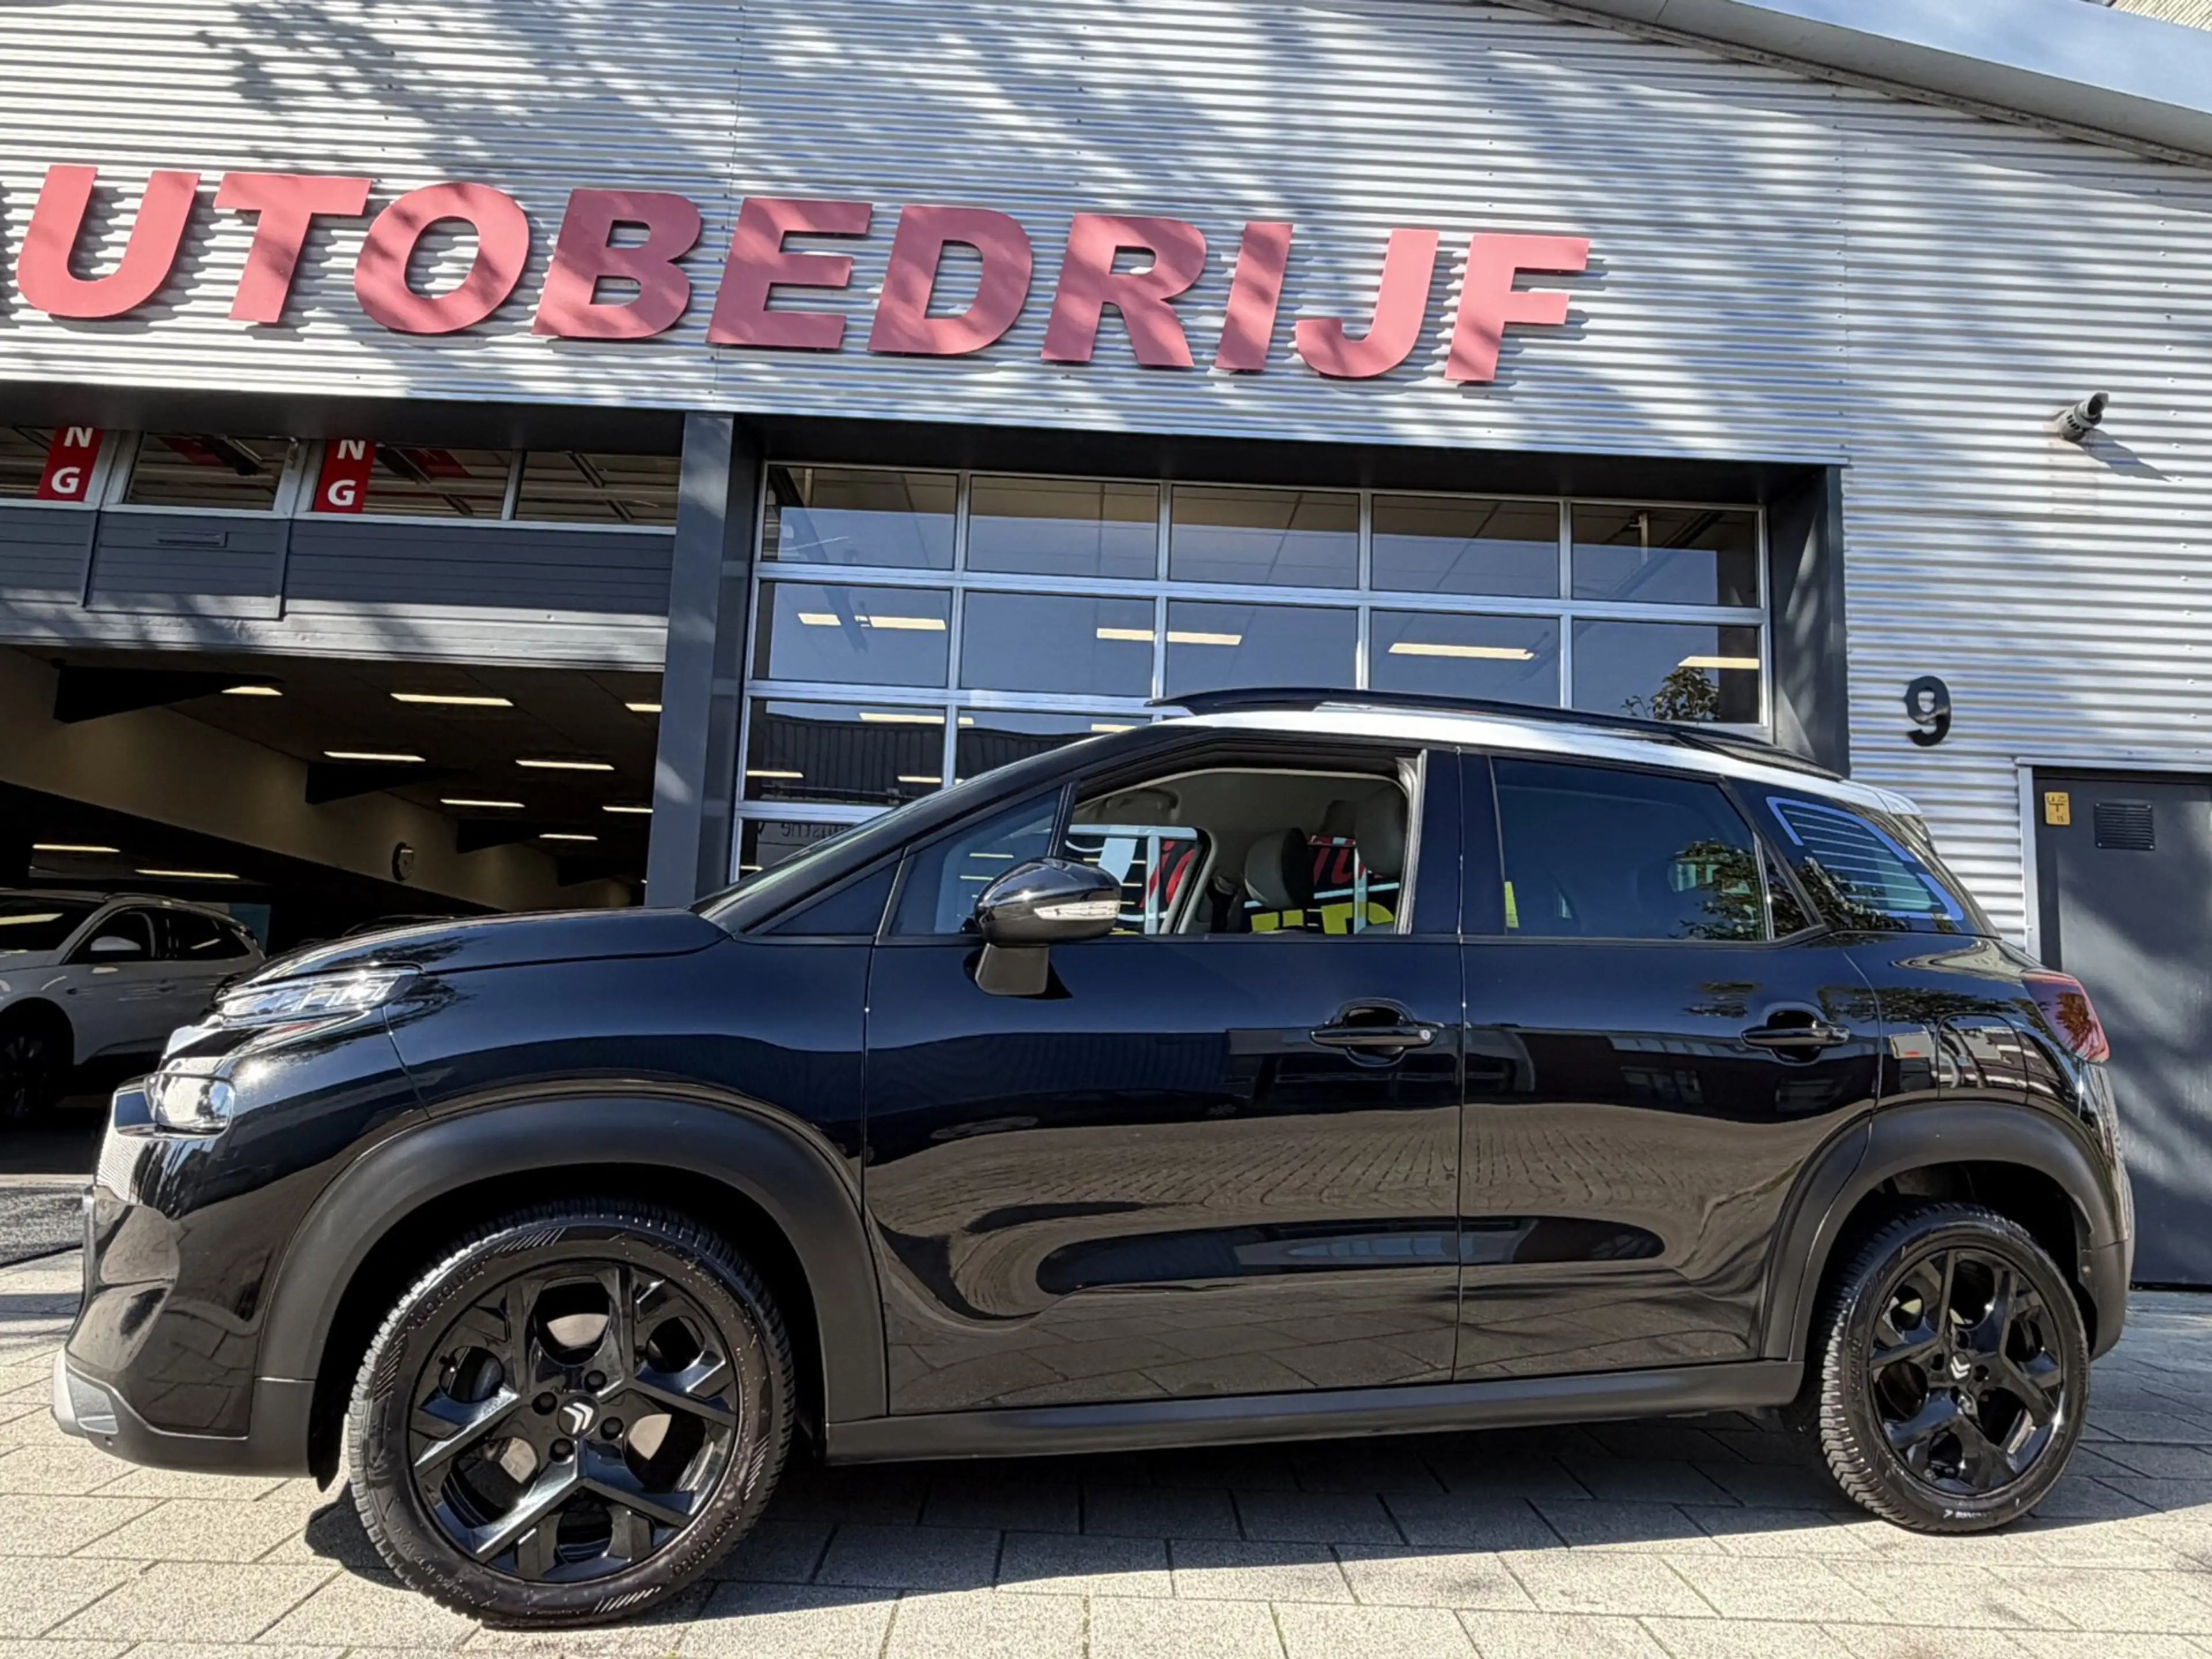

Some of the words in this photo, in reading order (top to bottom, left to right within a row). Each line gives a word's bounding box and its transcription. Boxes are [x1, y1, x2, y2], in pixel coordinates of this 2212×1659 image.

[16, 165, 1590, 382] UTOBEDRIJF
[1903, 676, 1952, 747] 9
[672, 1509, 740, 1577] Norauto
